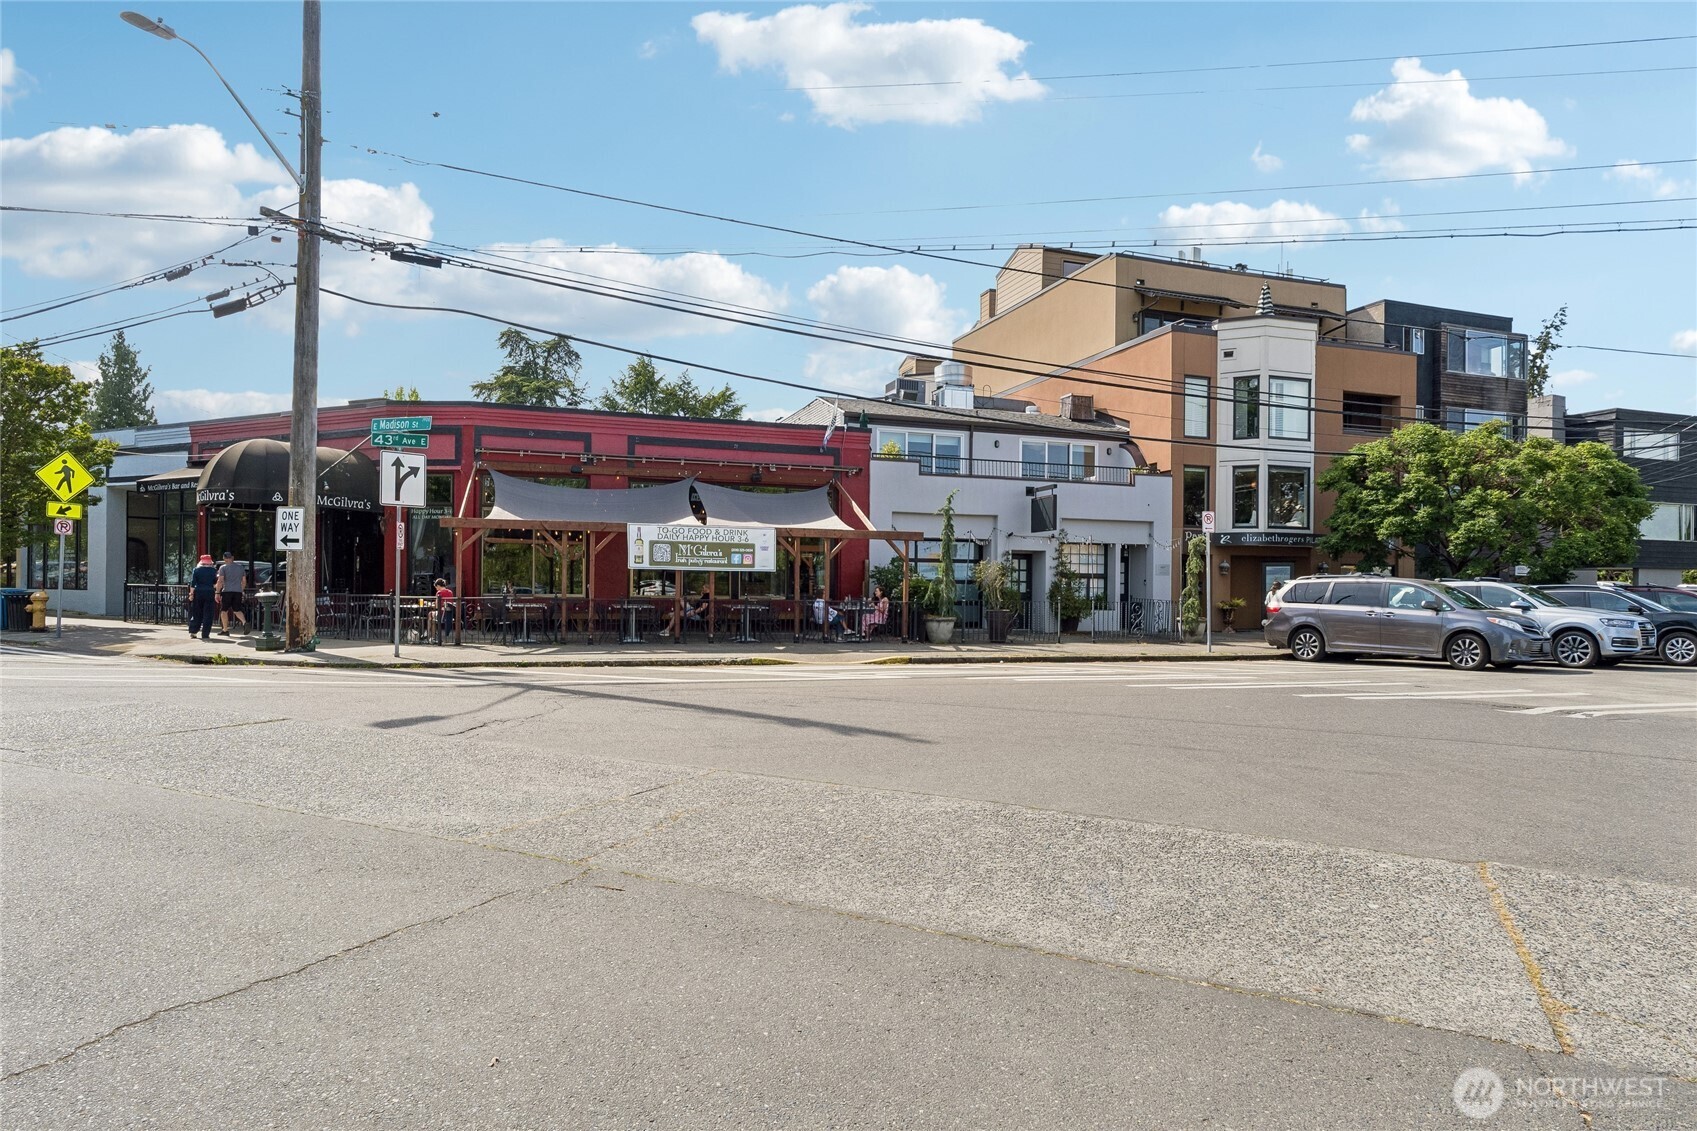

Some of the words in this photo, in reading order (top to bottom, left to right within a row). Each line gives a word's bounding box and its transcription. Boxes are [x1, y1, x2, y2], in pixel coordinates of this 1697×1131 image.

[373, 422, 378, 430] E
[380, 419, 410, 430] Madison
[374, 435, 399, 445] 43rd
[402, 437, 416, 445] Ave
[421, 438, 426, 446] E
[316, 495, 371, 510] McGilvra's
[282, 511, 299, 521] ONE
[281, 523, 300, 532] WAY
[1241, 533, 1304, 545] elizabethrogers
